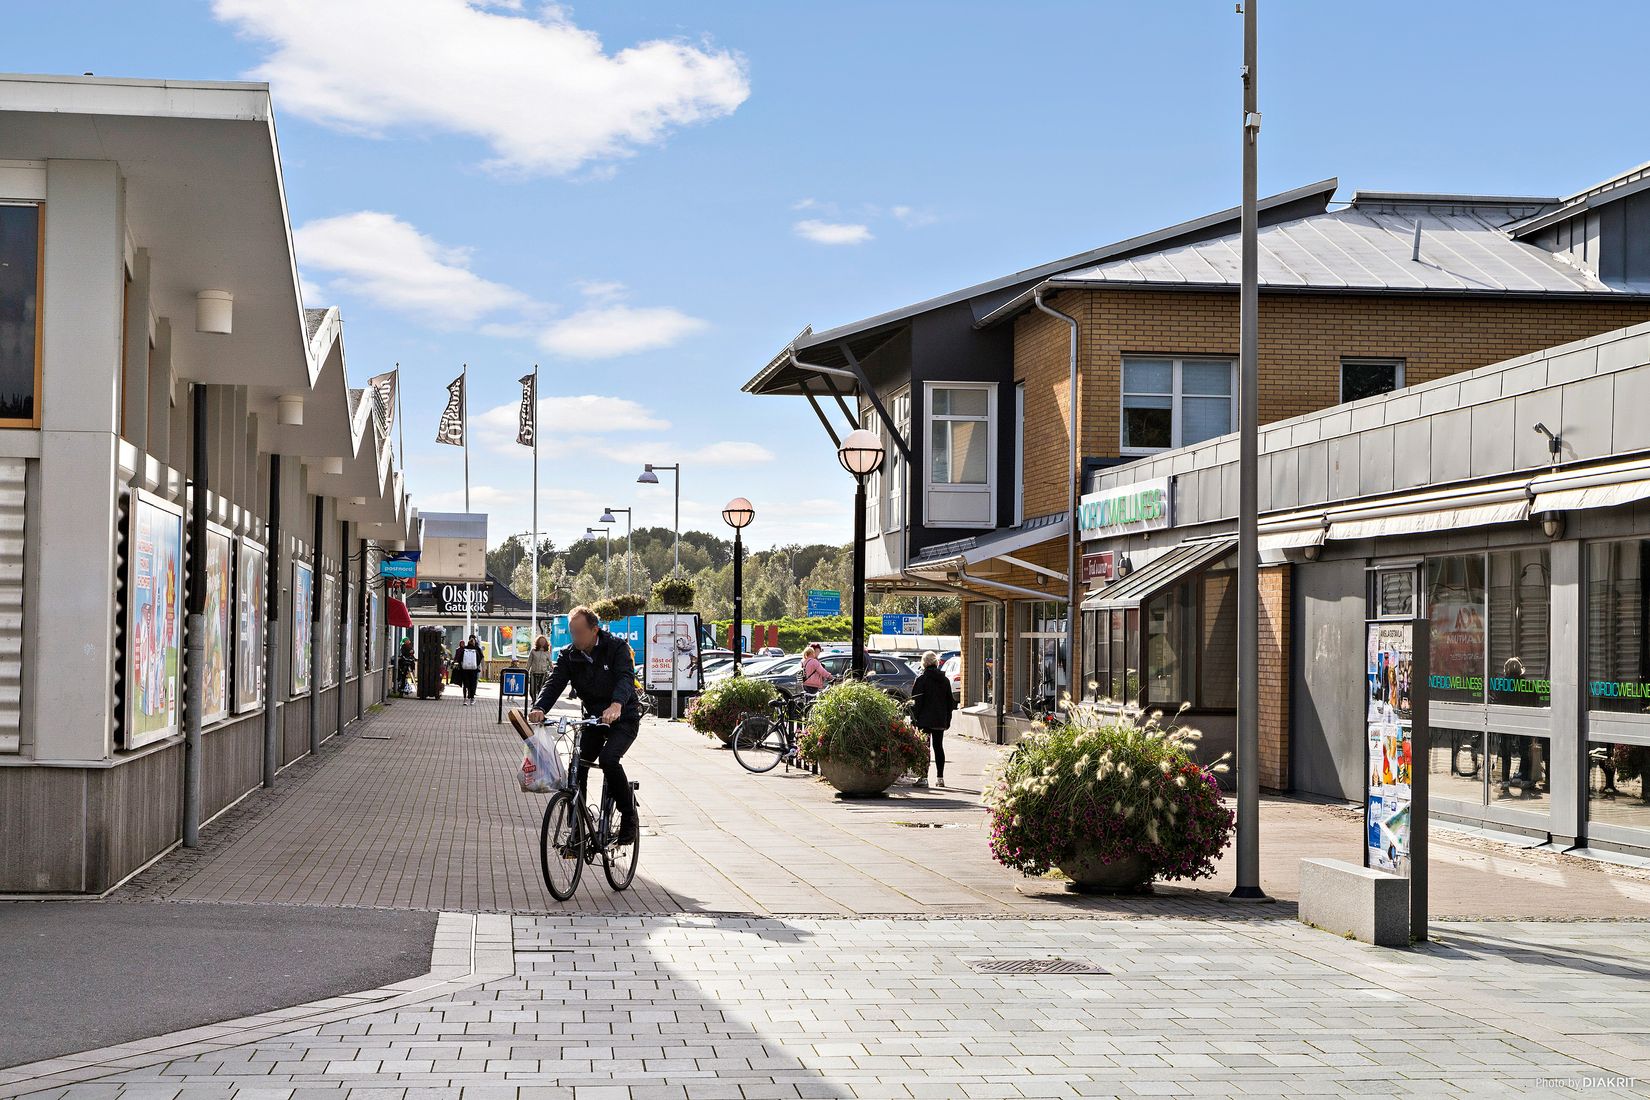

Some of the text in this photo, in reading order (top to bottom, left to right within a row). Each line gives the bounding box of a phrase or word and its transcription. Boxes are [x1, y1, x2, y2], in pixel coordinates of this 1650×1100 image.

[442, 585, 489, 603] Olssons
[445, 602, 486, 612] Gatukök
[1589, 681, 1650, 697] NORDICWELLNE
